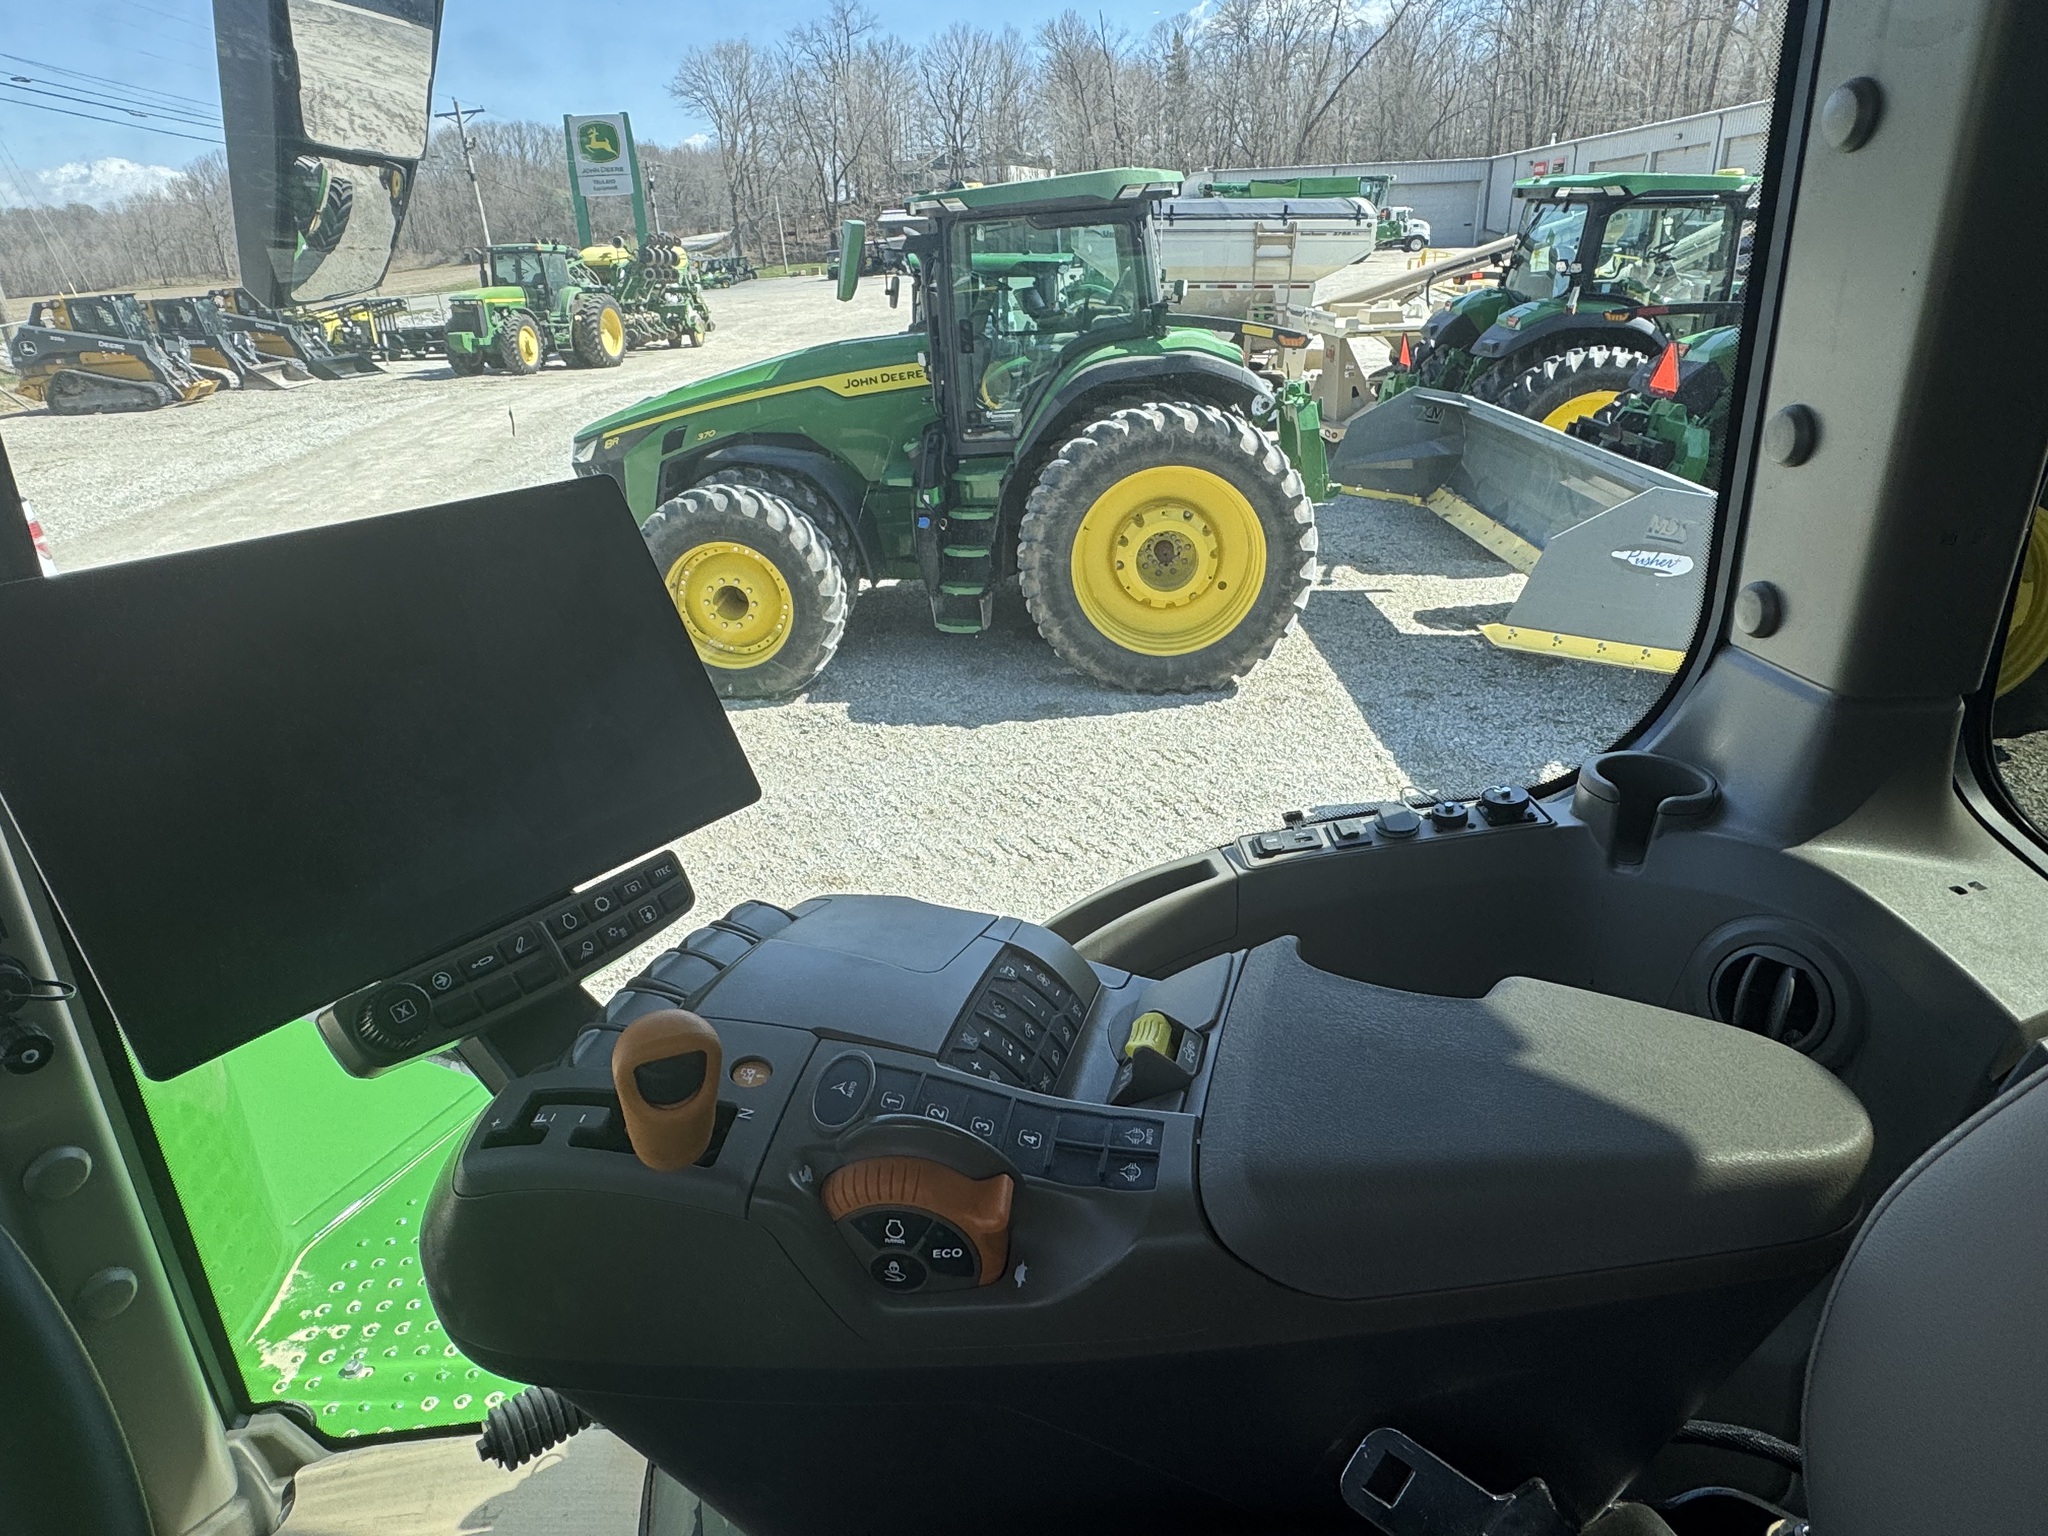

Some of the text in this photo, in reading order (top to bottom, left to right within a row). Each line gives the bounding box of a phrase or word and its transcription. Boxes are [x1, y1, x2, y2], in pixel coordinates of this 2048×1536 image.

[98, 340, 125, 350] DEERE
[844, 370, 923, 389] JOHN DEERE
[697, 429, 716, 440] 370
[604, 436, 620, 449] 8R
[846, 1080, 858, 1098] AUTO
[738, 1108, 755, 1120] N
[929, 1107, 946, 1119] 2
[975, 1119, 990, 1132] 3
[1022, 1133, 1039, 1146] 4
[1145, 1128, 1155, 1146] AUTO
[932, 1248, 963, 1259] ECO
